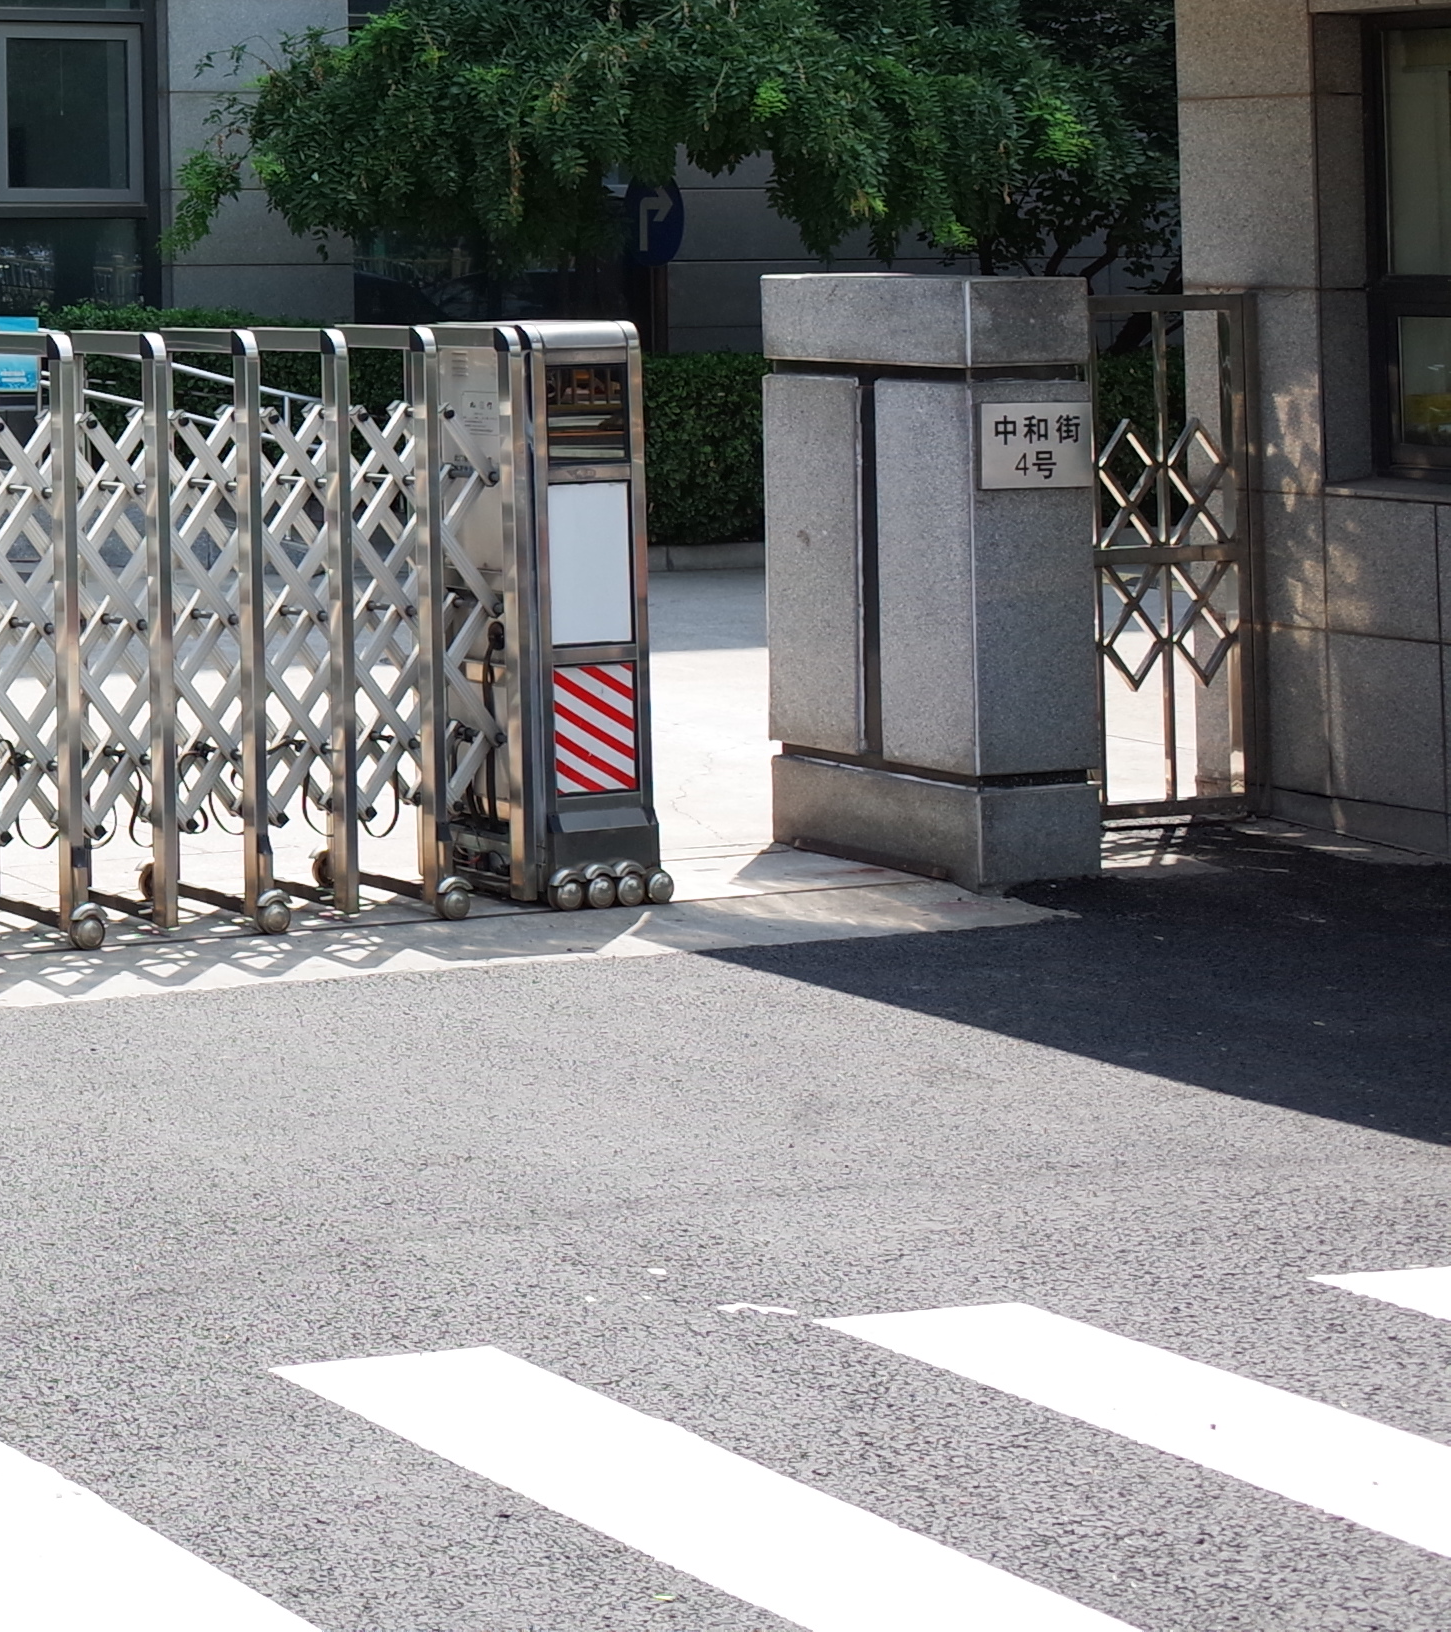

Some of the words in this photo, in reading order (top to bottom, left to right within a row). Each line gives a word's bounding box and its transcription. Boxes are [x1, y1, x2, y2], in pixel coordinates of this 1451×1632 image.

[994, 414, 1081, 446] 中和街
[1014, 450, 1058, 480] 4号
